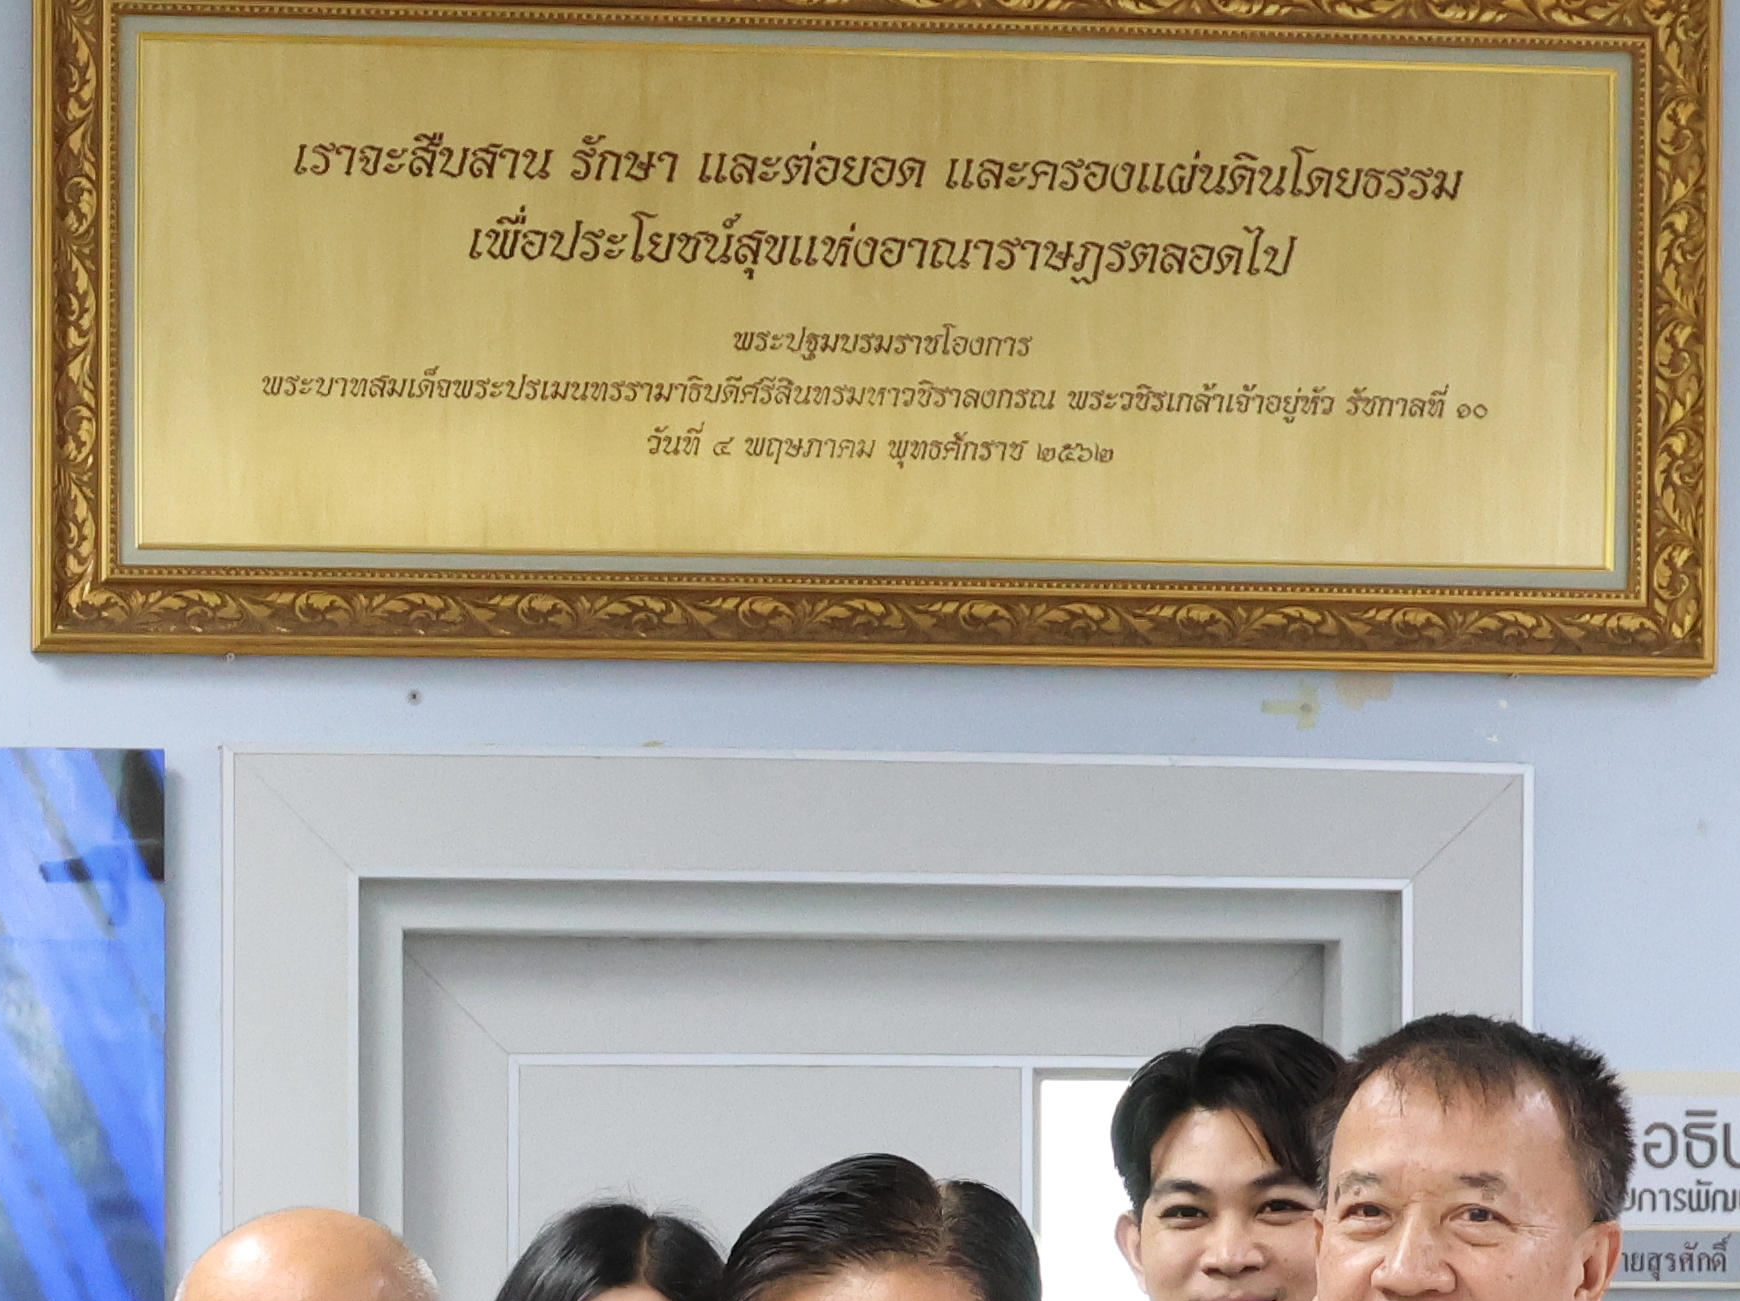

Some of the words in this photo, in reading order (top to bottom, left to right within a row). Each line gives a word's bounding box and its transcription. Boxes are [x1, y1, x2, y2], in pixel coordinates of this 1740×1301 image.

[292, 132, 554, 182] เราจะสืบสาน
[571, 135, 679, 184] รักษา
[698, 141, 926, 190] และต่อยอด
[947, 147, 1463, 202] และครองแผ่นดินโดยธรรม
[469, 205, 1298, 285] เพื่อประโยชน์สุขแห่งอาณาราษฎรตลอดไป
[734, 324, 1032, 360] พระปฐมบรมราชโองการ
[262, 365, 1055, 413] พระบาทสมเด็จพระปรเมนทรรามาธิบดีศรีสินทรมหาวชิราลงกรณ
[1067, 382, 1334, 424] พระวชิรเกล้าเจ้าอยู่หัว
[1346, 384, 1449, 419] รัชกาลที่
[1456, 402, 1488, 420] ๑๐
[646, 422, 705, 456] วันที่
[712, 435, 735, 456] ๔
[745, 432, 874, 464] พฤษภาคม
[887, 432, 1025, 468] พุทธศักราช
[1036, 441, 1114, 464] ๒๕๖๒
[1621, 1233, 1732, 1281] ายสุรศักดิ์
